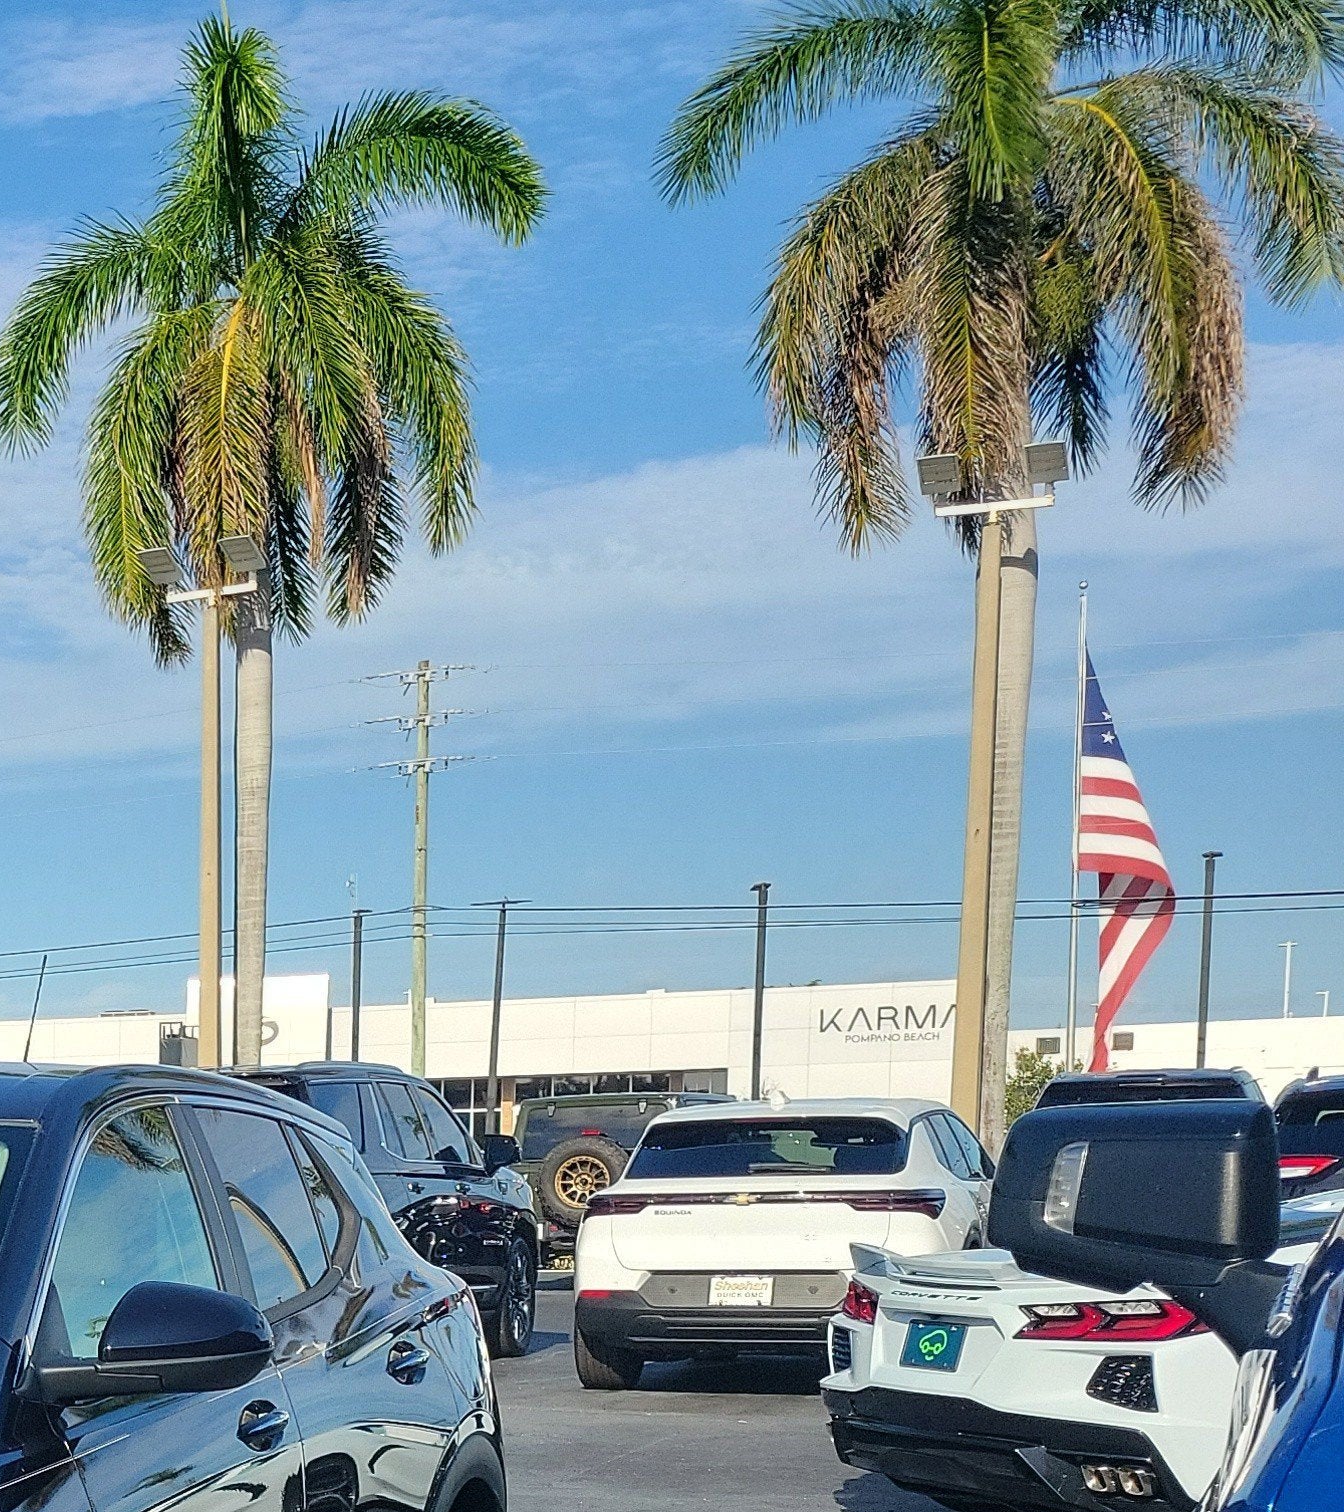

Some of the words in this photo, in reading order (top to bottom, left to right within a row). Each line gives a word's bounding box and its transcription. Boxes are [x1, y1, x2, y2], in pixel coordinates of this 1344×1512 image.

[845, 1033, 901, 1043] POMPANO
[904, 1032, 940, 1041] BEACH
[891, 1290, 983, 1300] CORVETTE
